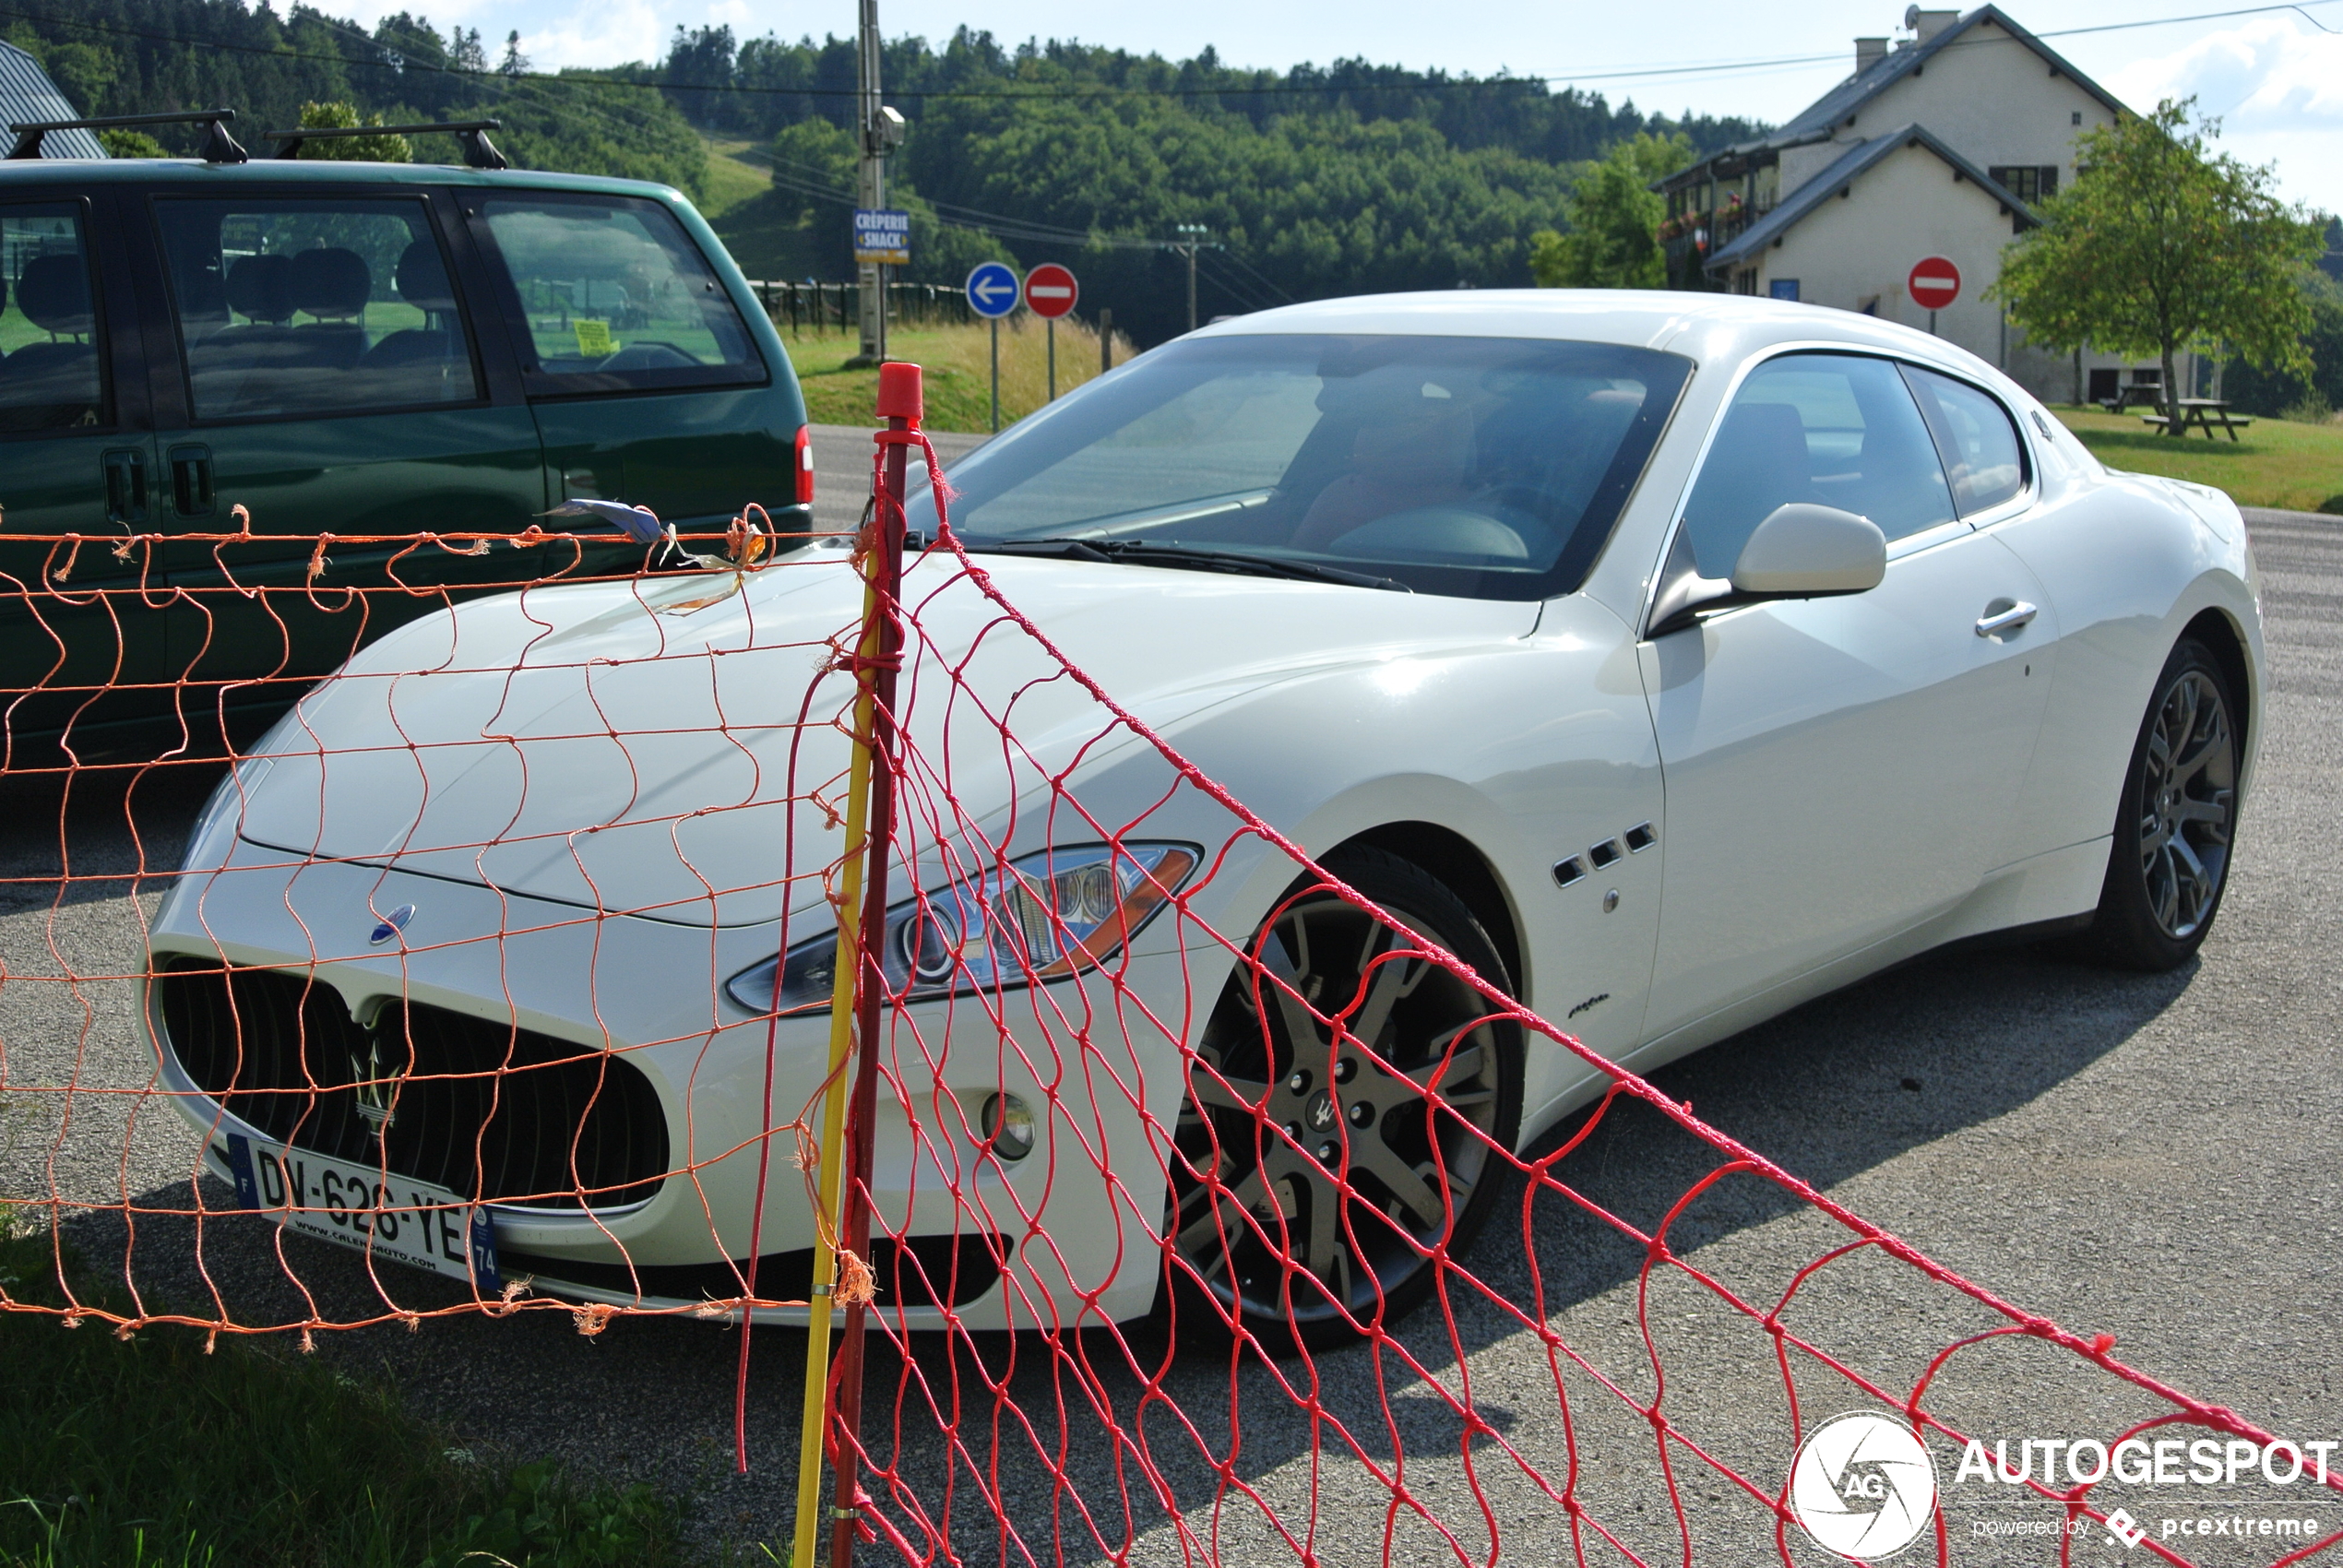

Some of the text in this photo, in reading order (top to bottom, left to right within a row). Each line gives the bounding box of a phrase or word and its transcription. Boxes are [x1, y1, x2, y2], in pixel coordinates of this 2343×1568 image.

[864, 232, 900, 248] SNACK
[241, 1178, 248, 1193] F
[257, 1150, 468, 1265] DV-626-YE
[476, 1245, 495, 1275] 74
